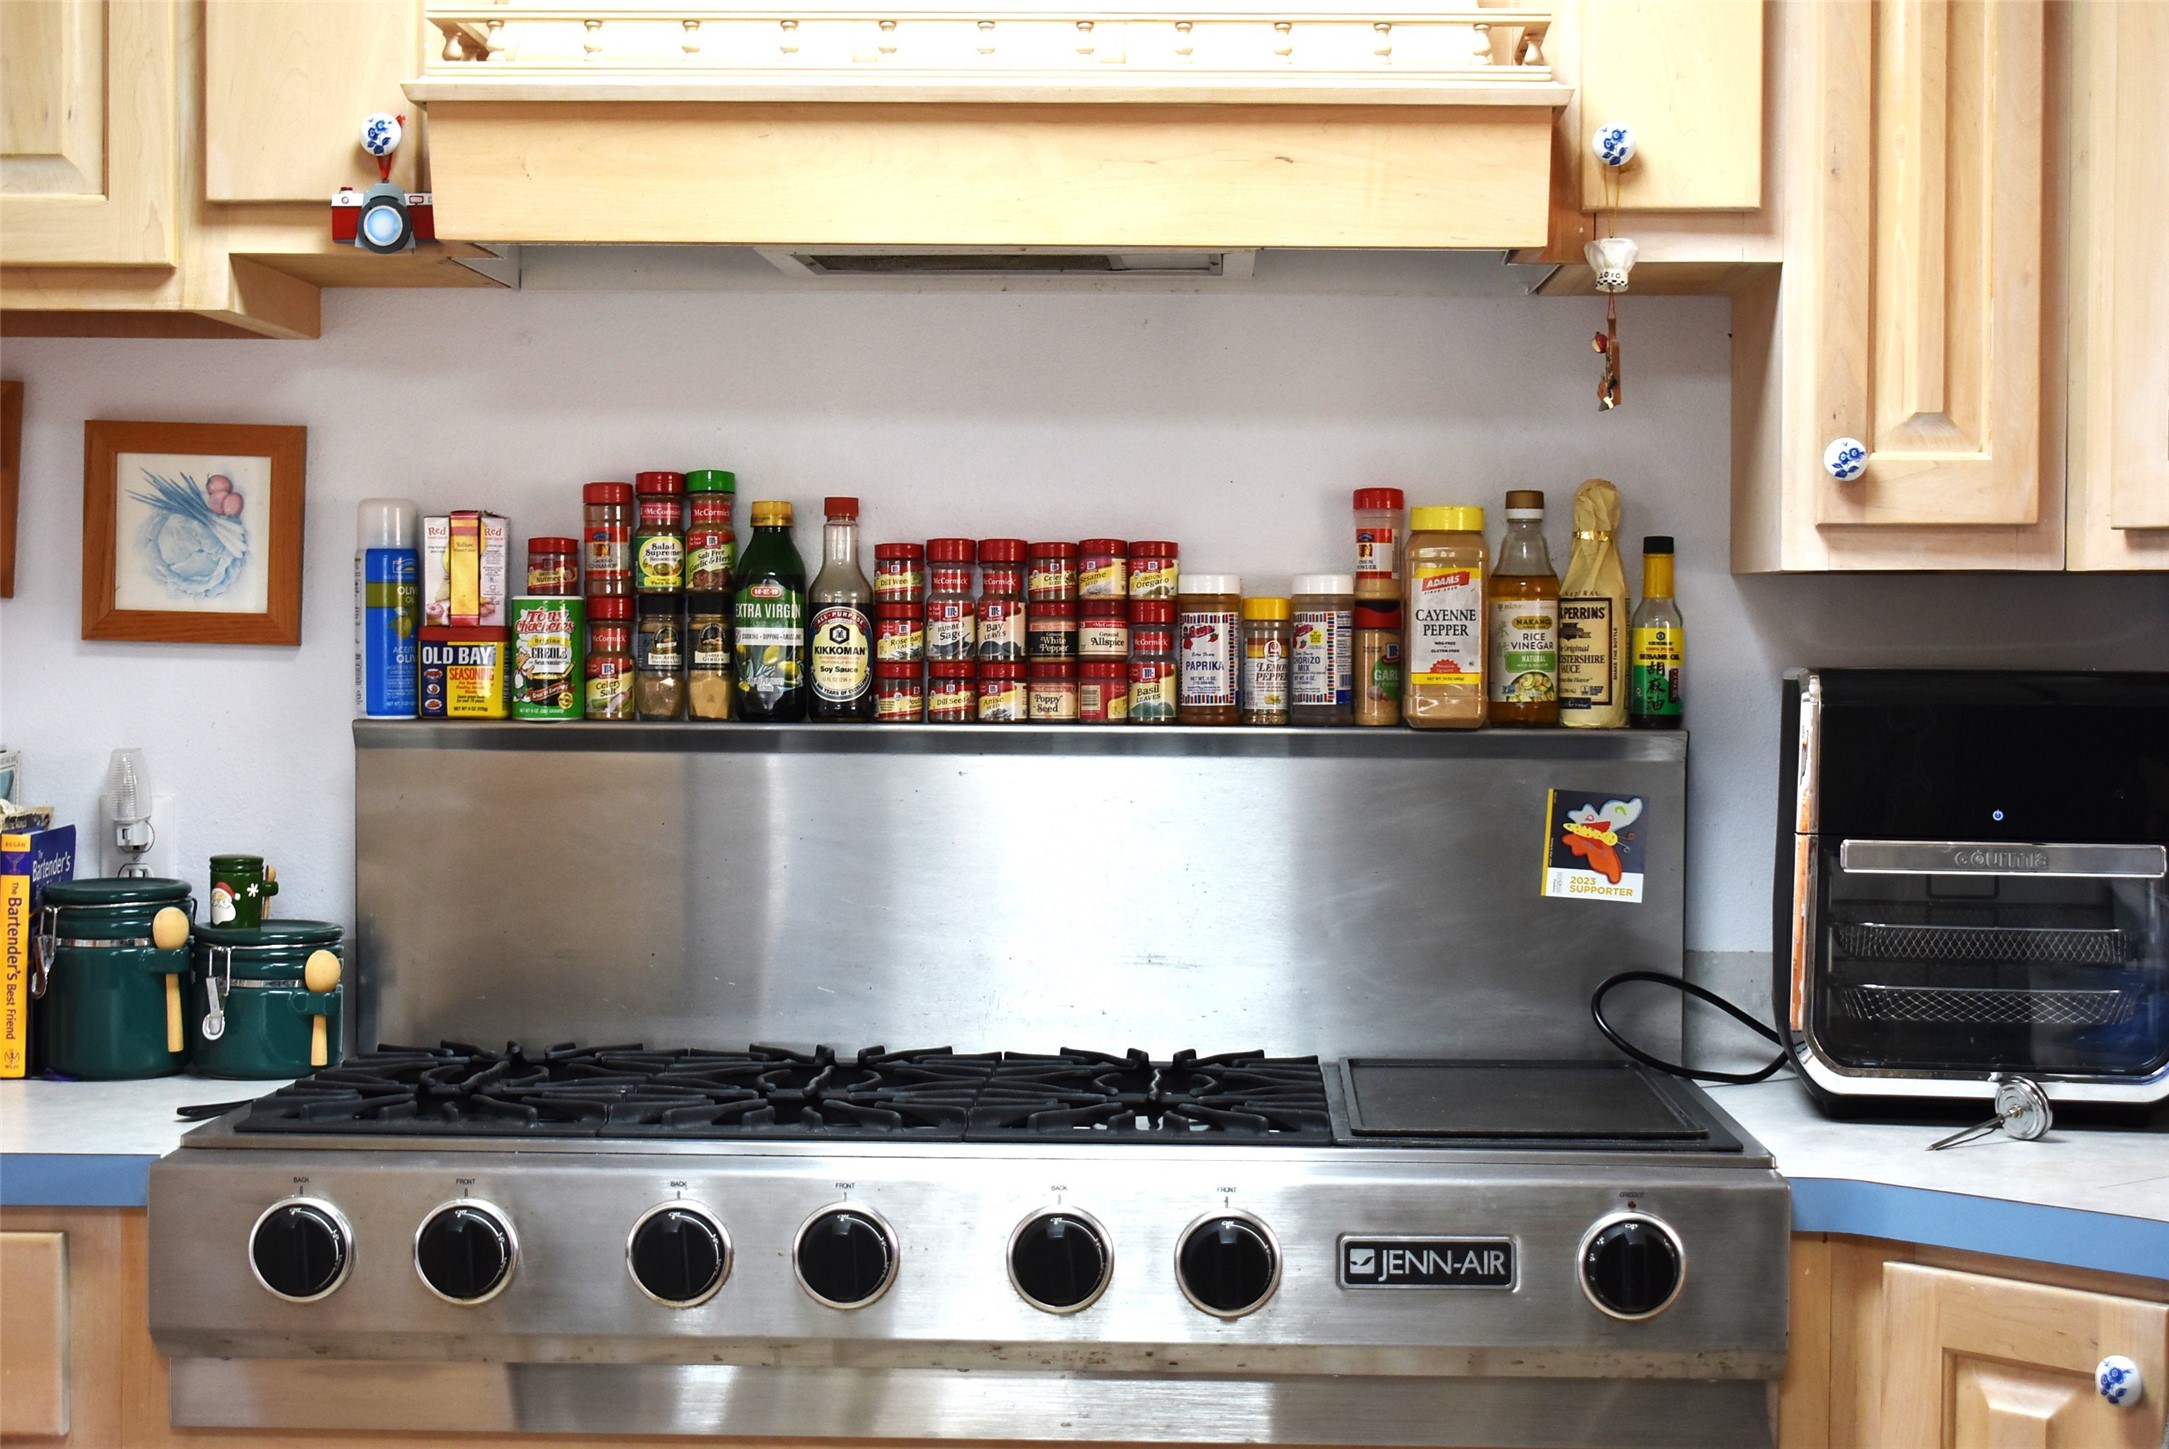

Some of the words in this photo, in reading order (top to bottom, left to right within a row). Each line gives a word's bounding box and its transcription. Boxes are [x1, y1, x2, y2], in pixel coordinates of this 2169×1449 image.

[428, 526, 447, 536] Red
[485, 526, 502, 536] Red
[652, 542, 675, 551] Salad
[645, 550, 681, 560] Supreme
[698, 551, 710, 560] Salt
[711, 549, 725, 558] Free
[690, 559, 708, 572] Garlic
[933, 577, 968, 585] McCormck
[984, 577, 1015, 585] cCormick
[1044, 574, 1067, 582] Celer
[1080, 572, 1107, 583] Sesame
[1426, 575, 1460, 588] ADAMS
[736, 603, 762, 618] EXTRA
[1415, 608, 1477, 622] CAYENNE
[986, 622, 1004, 633] Bay
[1516, 618, 1551, 626] NAKANO
[939, 630, 964, 642] Sage
[1423, 624, 1469, 637] PEPPER
[891, 634, 922, 646] Roseary
[1040, 636, 1067, 645] White
[1522, 632, 1547, 641] RICE
[1091, 637, 1125, 648] Allspice
[1510, 641, 1554, 650] VINEGAR
[531, 647, 568, 659] CREOLE
[814, 646, 866, 656] KIKKOMAN
[1040, 645, 1069, 653] Pepper
[1563, 645, 1590, 654] Original
[396, 654, 416, 664] OLIV
[422, 646, 454, 665] OLD
[458, 646, 492, 665] BAY
[1293, 656, 1321, 665] CHORIZO
[1521, 655, 1547, 663] NATURAL
[820, 665, 833, 674] Soy
[835, 665, 859, 673] Sauce
[1185, 661, 1224, 671] PAPRIKA
[1257, 662, 1288, 673] LEMON
[1374, 669, 1399, 681] GARL
[595, 680, 621, 691] Celery
[1137, 684, 1160, 697] Basil
[600, 687, 616, 698] Salt
[937, 697, 948, 706] Dill
[1034, 694, 1063, 704] Poppy
[1137, 694, 1161, 703] LEAVES
[1037, 704, 1058, 712] Seed
[32, 850, 71, 881] Bartender's
[1570, 876, 1596, 885] 2023
[11, 882, 19, 895] The
[1569, 885, 1633, 897] SUPPORTER
[7, 897, 22, 981] Bartender's
[6, 984, 17, 1006] Best
[5, 1009, 16, 1041] Friend
[1377, 1249, 1506, 1282] JENN-AIR
